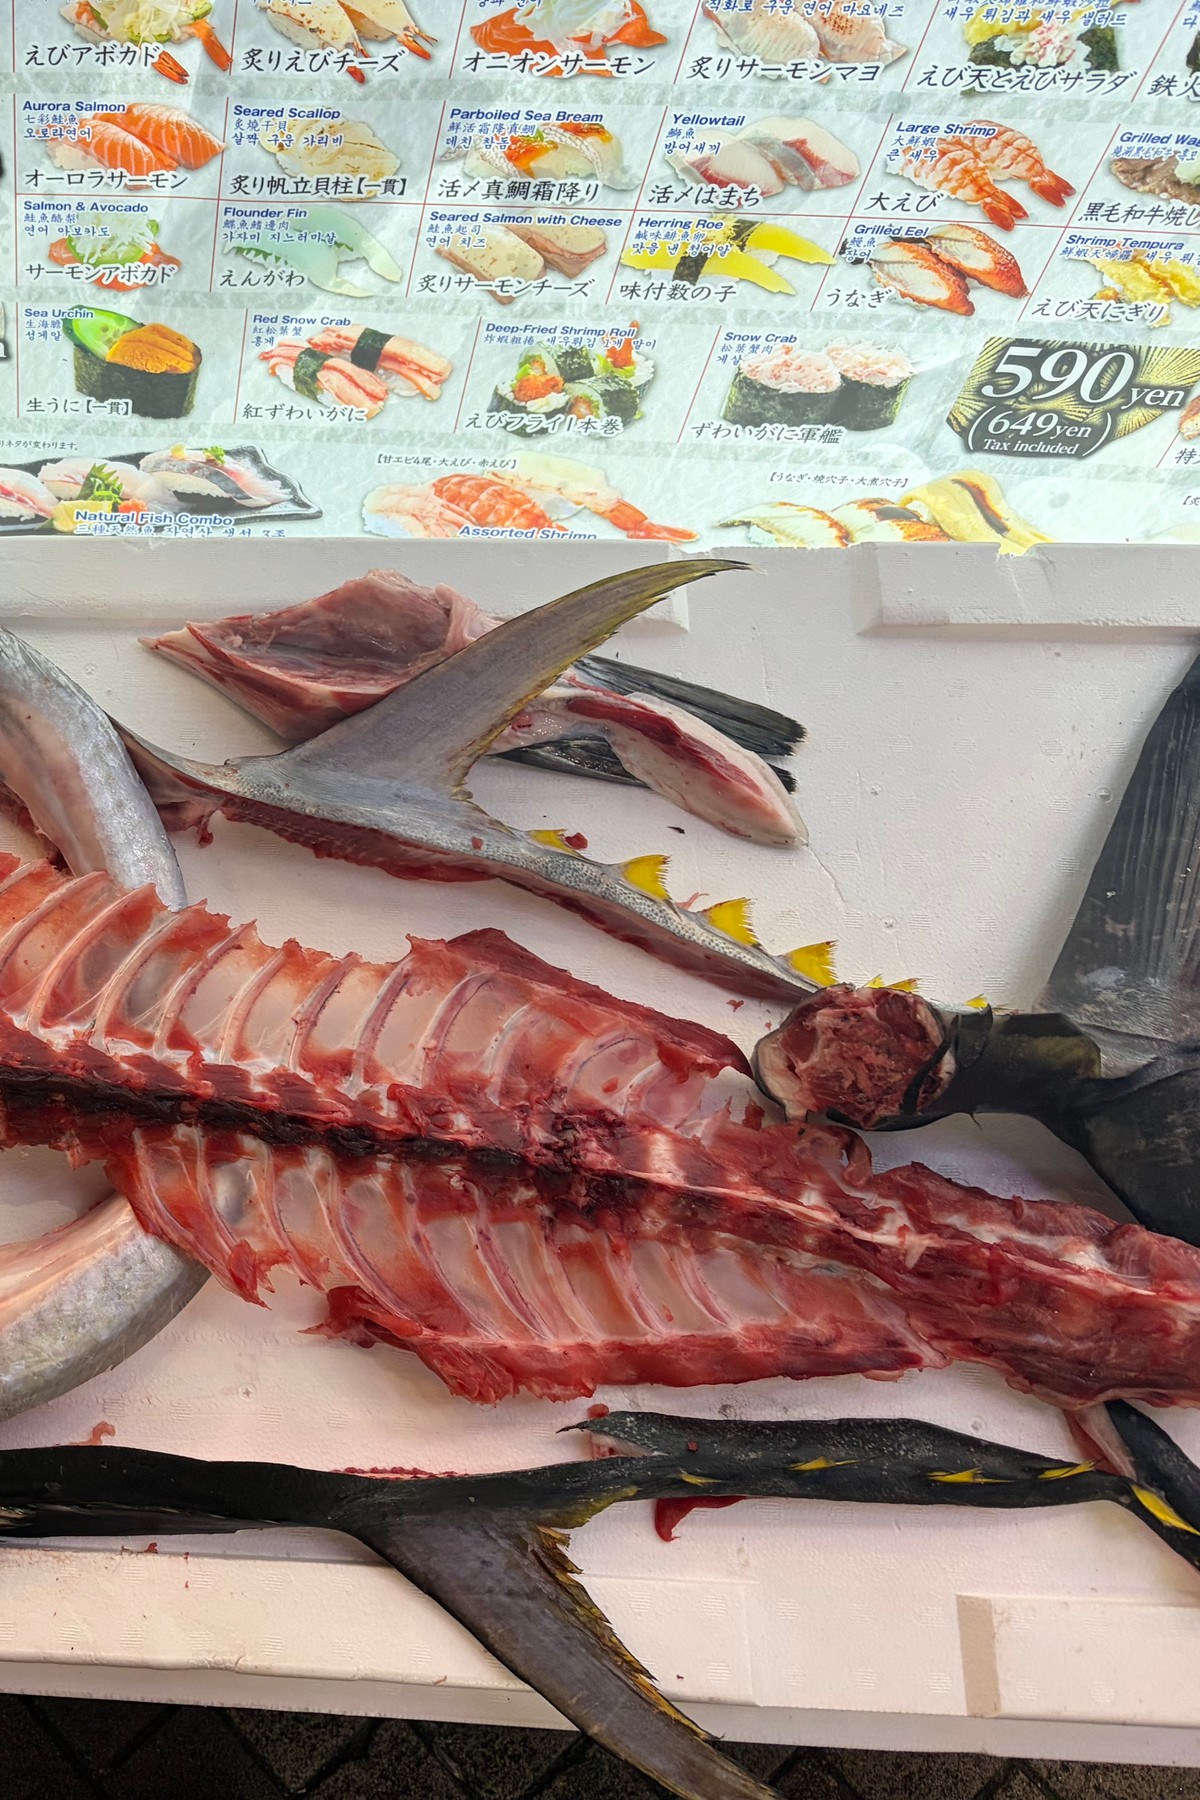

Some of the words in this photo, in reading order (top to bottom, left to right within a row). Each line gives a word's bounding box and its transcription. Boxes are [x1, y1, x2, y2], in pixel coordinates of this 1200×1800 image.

[762, 0, 794, 15] 구운
[802, 2, 832, 16] 연어
[843, 3, 904, 17] 마요네즈
[943, 6, 974, 22] 새우
[1039, 9, 1070, 25] 새우
[1080, 11, 1127, 27] 샐러드
[25, 44, 160, 67] えびアボカド
[241, 48, 405, 73] 炙りえびチーズ
[462, 51, 655, 75] オニオンサーモン
[686, 56, 881, 81] 炙りサーモンマヨ
[918, 64, 1138, 96] えび天とえびサラダ
[23, 101, 71, 112] Aurora
[75, 101, 126, 112] Salmon
[233, 105, 285, 118] Seared
[288, 108, 341, 120] Scallop
[24, 114, 79, 126] 七彩鮭魚
[450, 108, 521, 121] Parboiled
[524, 110, 552, 122] Sea
[556, 111, 603, 122] Bream
[673, 114, 746, 126] Yellowtail
[23, 128, 92, 140] 오로라연어
[896, 122, 940, 134] Large
[944, 123, 997, 137] Shrimp
[232, 132, 259, 145] 살짝
[267, 133, 294, 147] 구운
[303, 134, 343, 147] 가리비
[1120, 131, 1172, 144] Grilled
[886, 149, 900, 162] 큰
[908, 149, 938, 163] 새우
[25, 169, 188, 189] オーロラサーモン
[230, 175, 407, 196] 炙り帆立貝柱【一貫】
[23, 200, 72, 211] Salmon
[75, 201, 86, 212] &
[90, 202, 149, 213] Avocado
[864, 192, 945, 213] 大えび
[224, 207, 284, 217] Flounder
[287, 208, 307, 218] Fin
[430, 211, 479, 222] Seared
[482, 212, 533, 224] Salmon
[537, 214, 566, 225] with
[570, 215, 623, 227] Cheese
[24, 225, 48, 237] 연어
[58, 225, 110, 237] 아보카도
[638, 217, 693, 230] Herring
[695, 219, 724, 229] Roe
[854, 224, 902, 236] Grilled
[905, 226, 930, 237] Eel
[222, 231, 260, 243] 가자미
[425, 236, 451, 248] 연어
[460, 237, 486, 248] 치즈
[1066, 234, 1117, 247] Shrimp
[1121, 237, 1185, 250] Tempura
[690, 243, 730, 257] 청어알
[845, 250, 871, 262] 장어
[1145, 251, 1172, 263] 새우
[26, 264, 176, 284] サーモンアボカド
[219, 269, 305, 287] えんがわ
[416, 274, 595, 298] 炙りサーモンチーズ
[620, 282, 737, 303] 味付数の子
[827, 289, 893, 309] うなぎ
[25, 308, 48, 317] Sea
[52, 309, 94, 319] Urchin
[1031, 299, 1165, 324] えび天にぎり
[253, 315, 278, 324] Red
[282, 315, 317, 325] Snow
[320, 316, 351, 326] Crab
[486, 323, 557, 334] Deep-Fried
[560, 326, 605, 337] Shrimp
[609, 328, 637, 337] Roll
[724, 332, 762, 342] Snow
[765, 333, 798, 344] Crab
[981, 346, 1135, 404] 590
[1121, 386, 1186, 410] yen
[26, 397, 131, 416] 生うに【一貫】
[242, 403, 368, 422] 紅ずわいがに
[691, 423, 844, 444] ずわいがに軍艦
[983, 438, 1011, 451] Tax
[1013, 440, 1080, 455] included
[75, 511, 135, 522] Natural
[139, 513, 173, 523] Fish
[177, 514, 233, 526] Combo
[459, 525, 535, 539] Assorted
